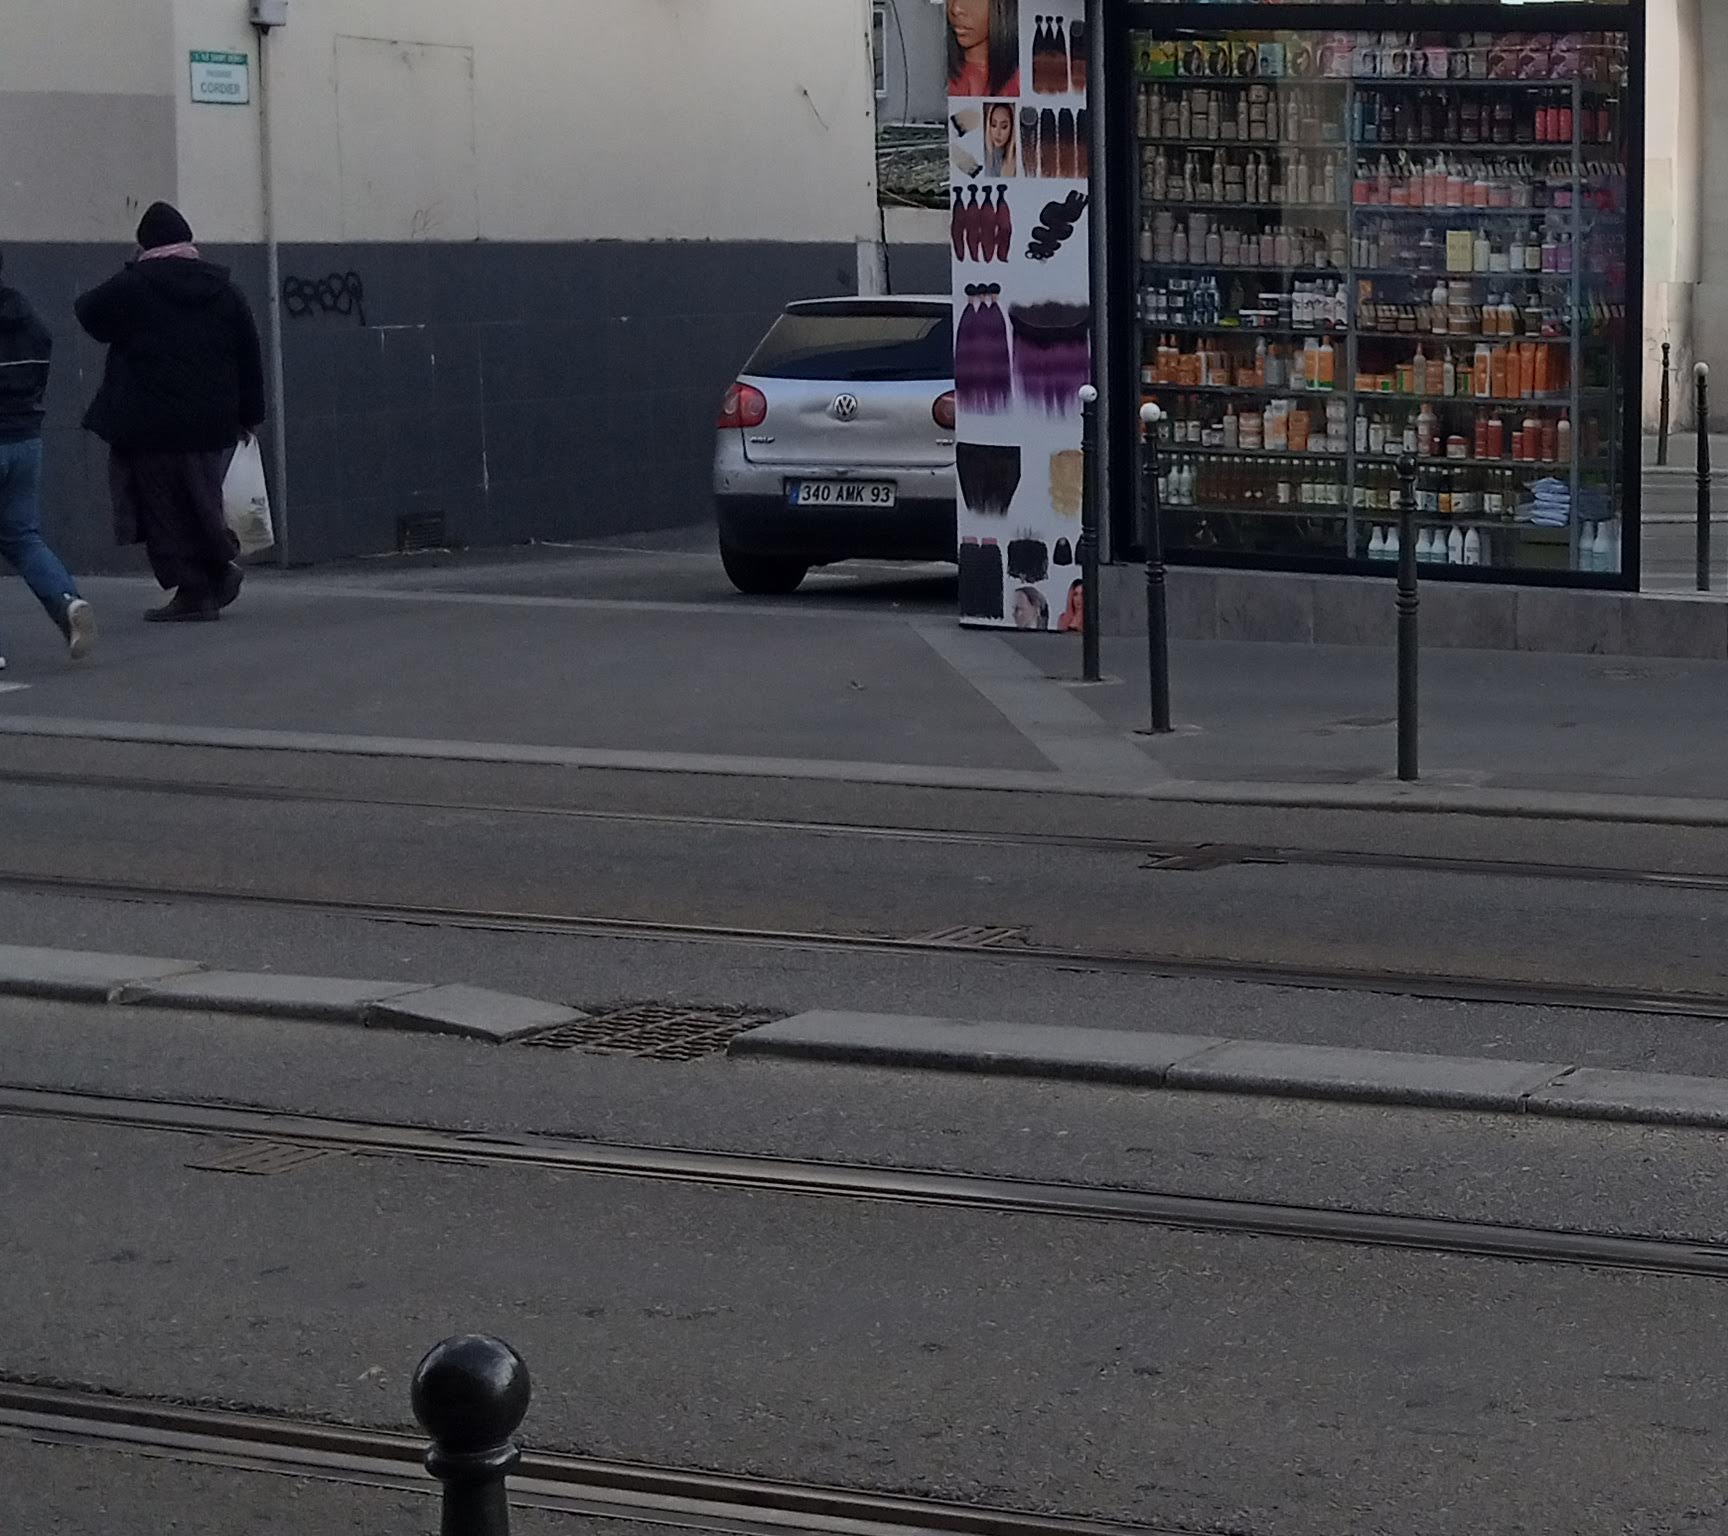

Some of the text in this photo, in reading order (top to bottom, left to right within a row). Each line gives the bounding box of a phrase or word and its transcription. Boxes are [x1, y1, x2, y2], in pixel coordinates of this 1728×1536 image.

[802, 485, 890, 503] 340 AMK 93
